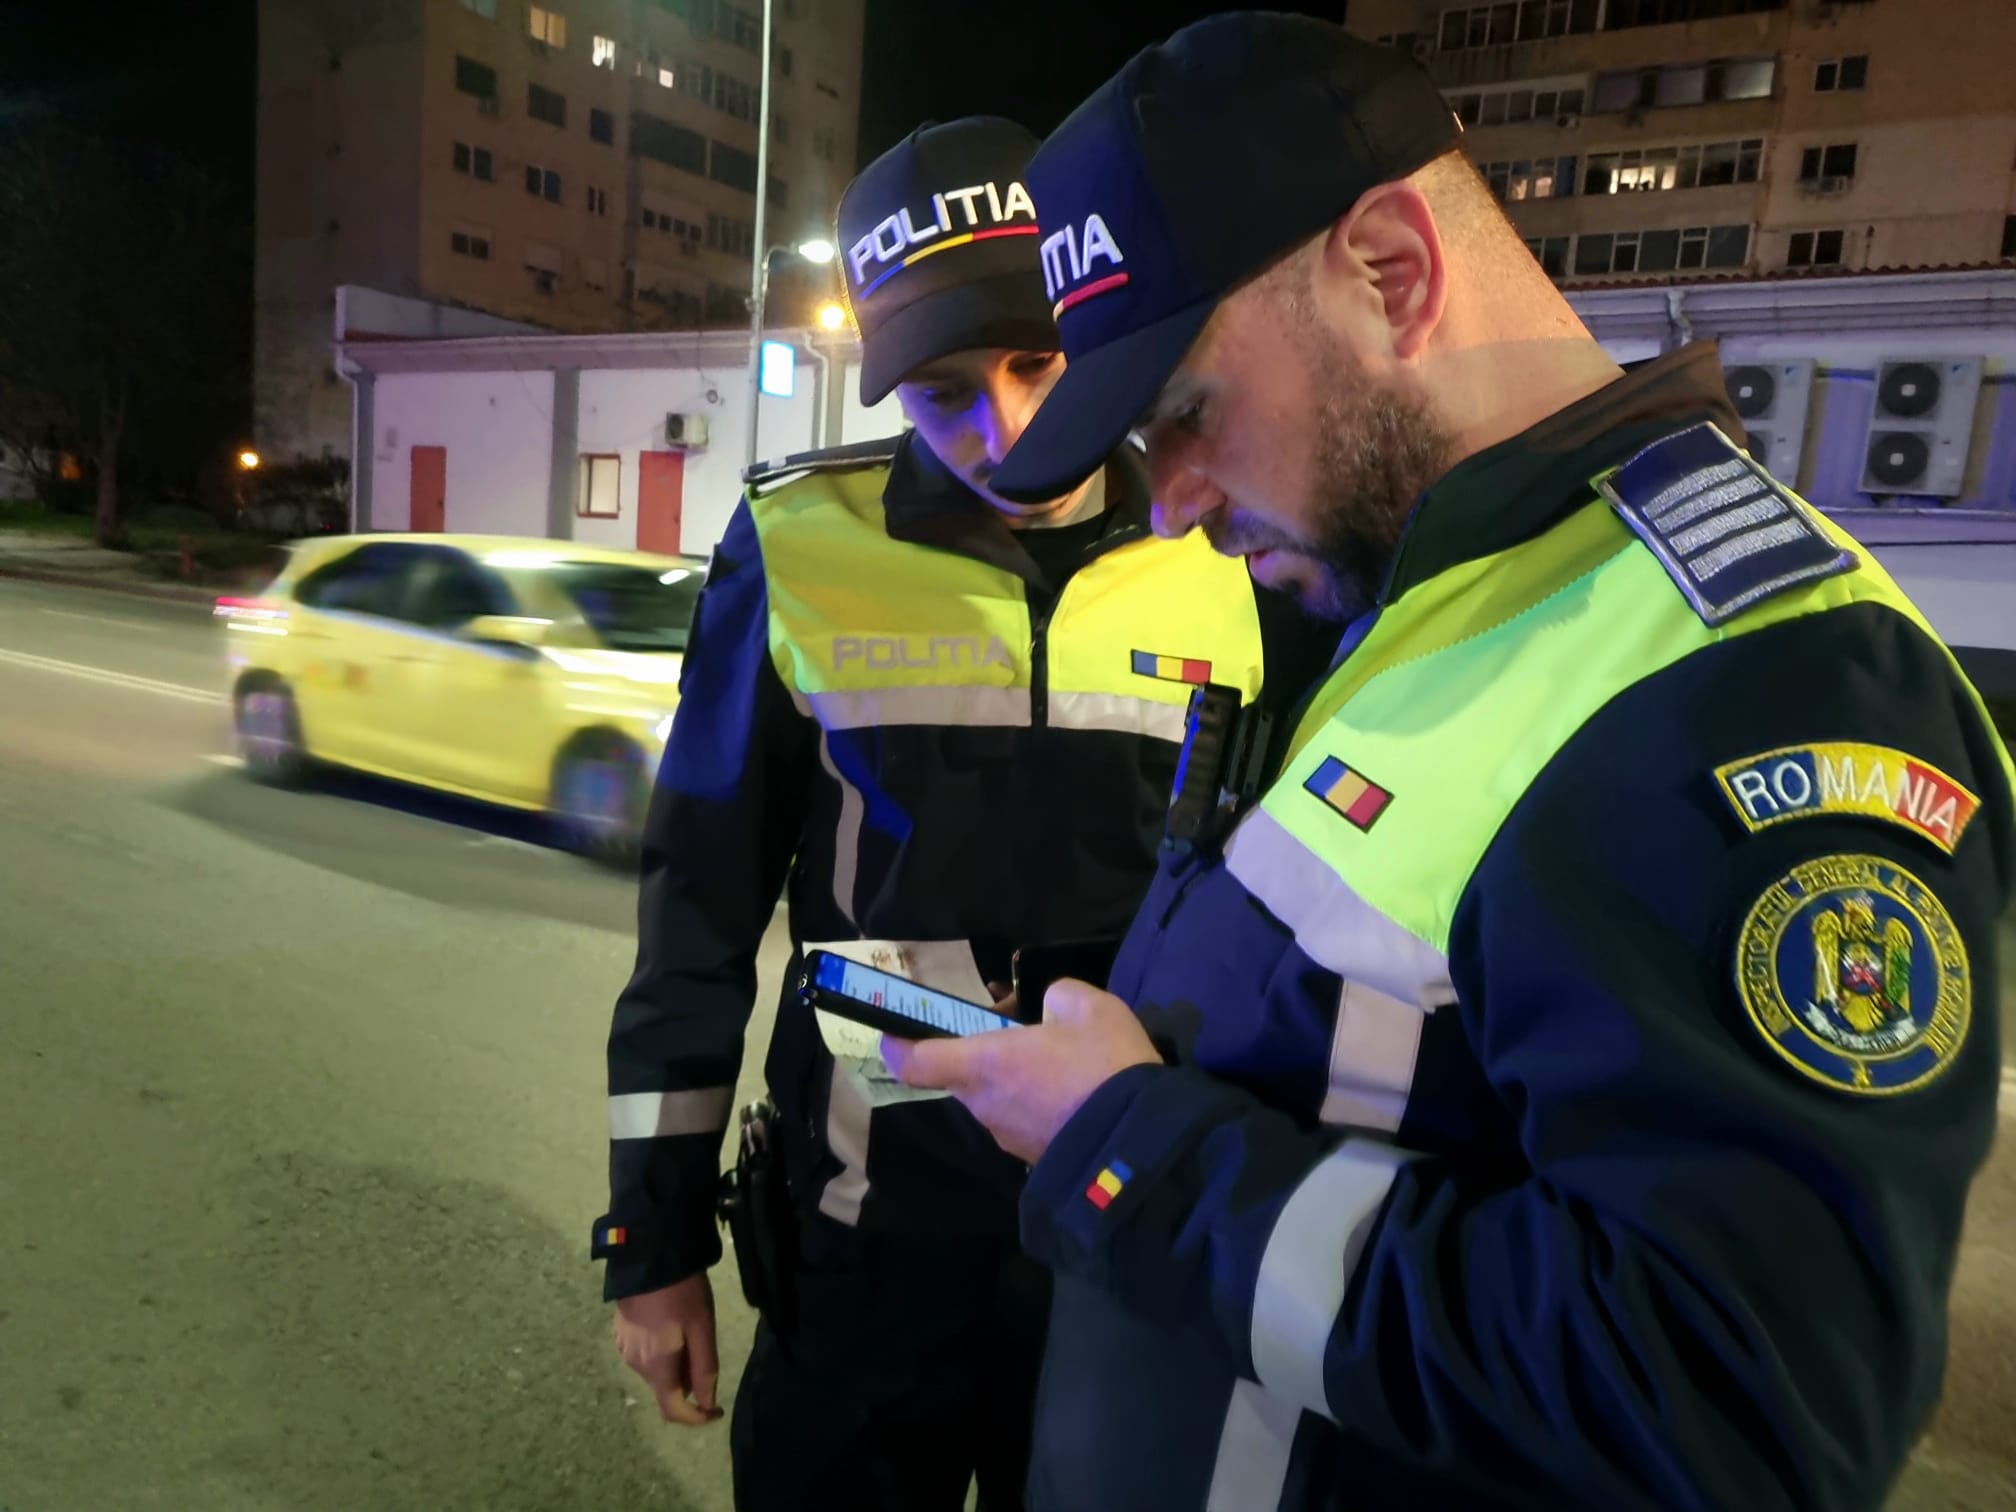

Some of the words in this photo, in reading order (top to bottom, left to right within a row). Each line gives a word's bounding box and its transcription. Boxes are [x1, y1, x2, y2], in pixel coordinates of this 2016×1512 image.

[849, 181, 1036, 285] POLITIA
[833, 634, 1013, 672] POLITIA
[1732, 755, 1957, 850] ROMANIA
